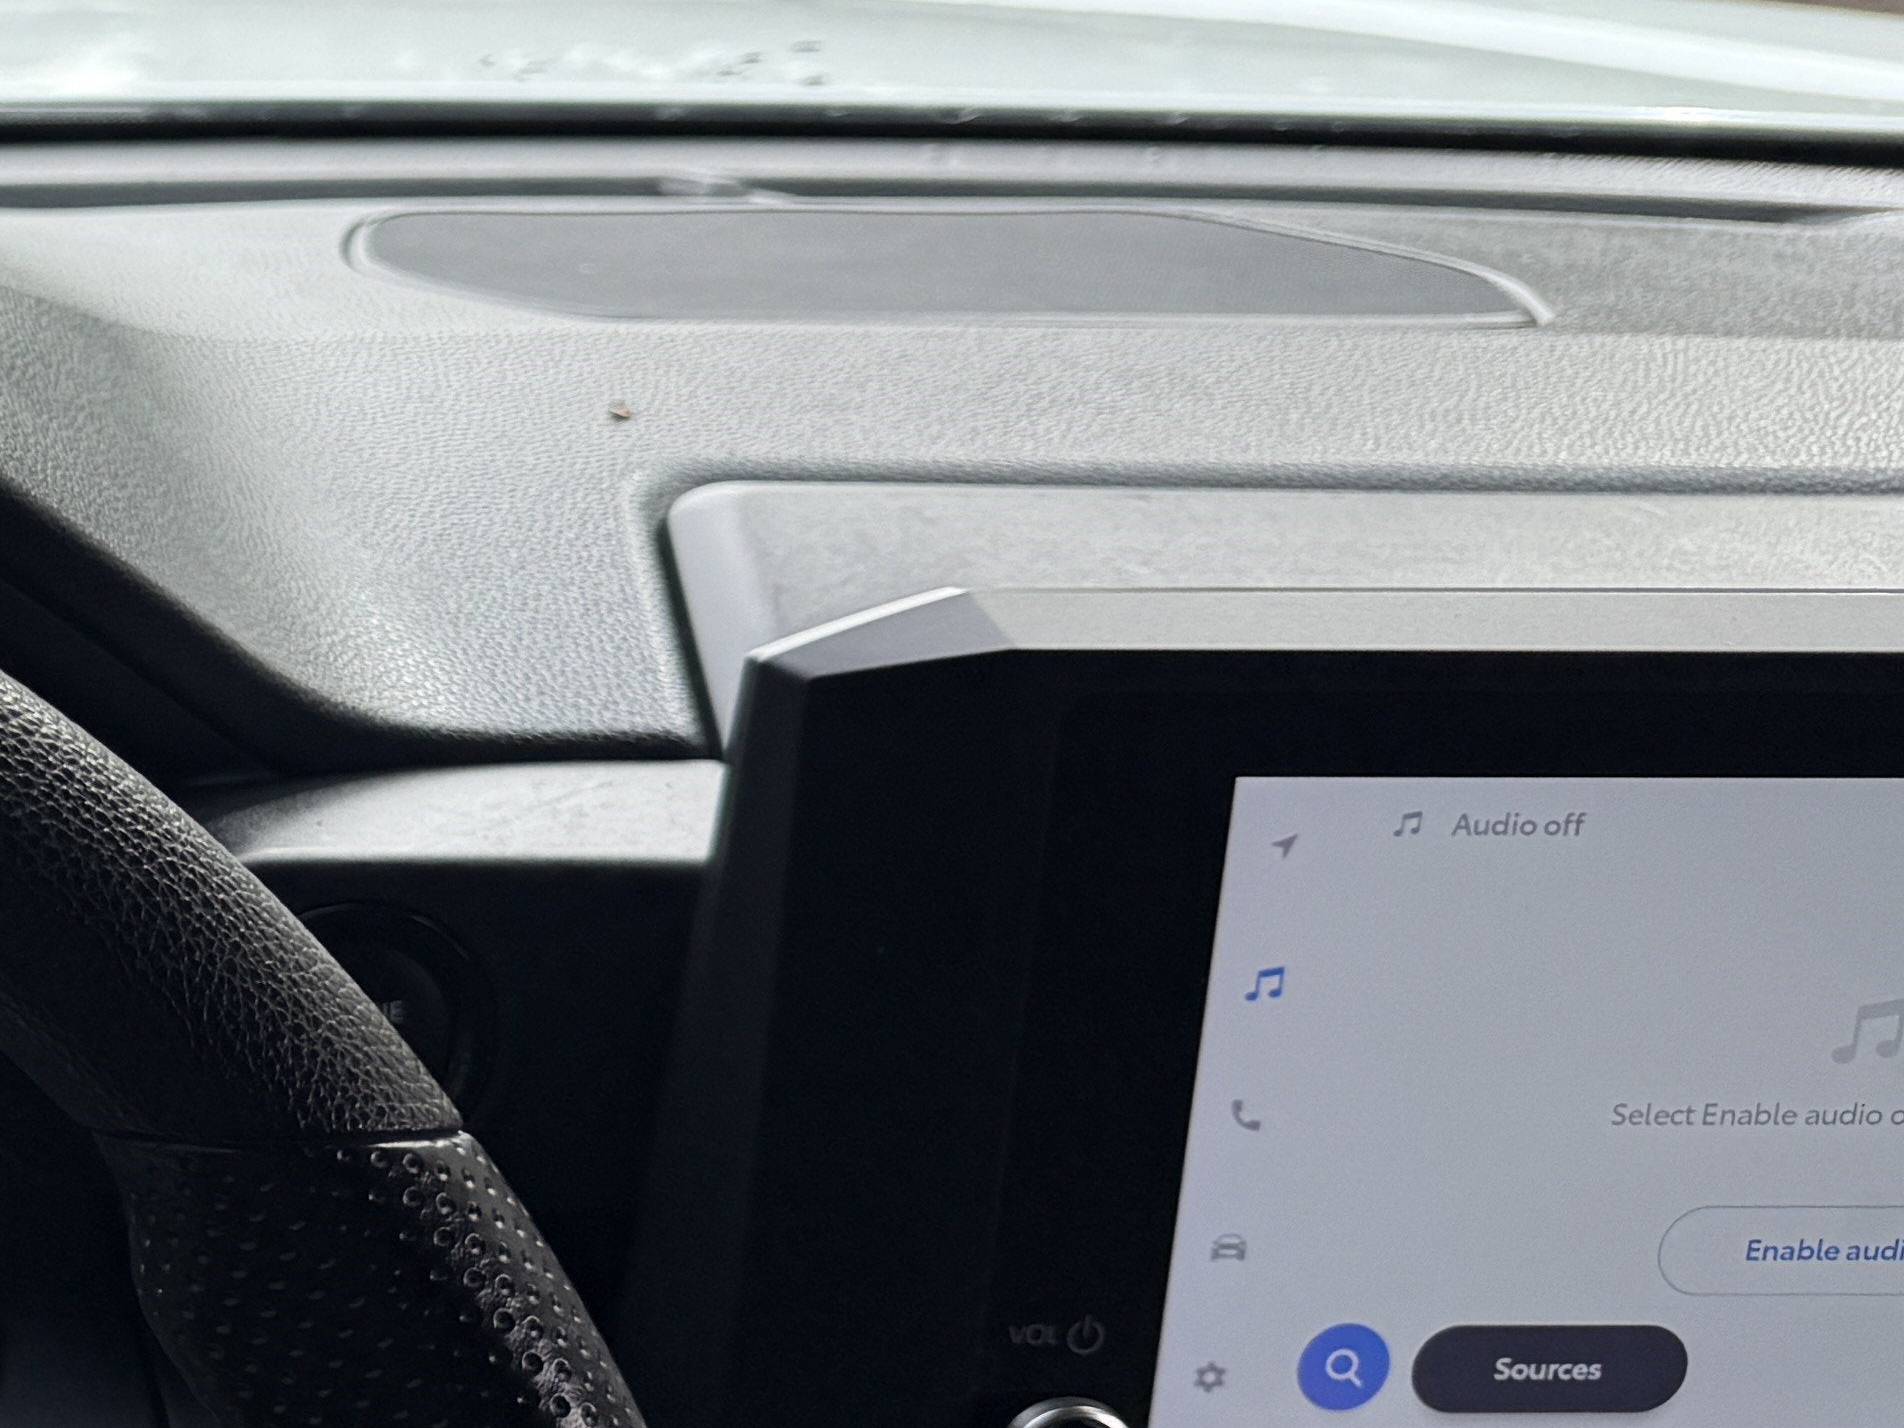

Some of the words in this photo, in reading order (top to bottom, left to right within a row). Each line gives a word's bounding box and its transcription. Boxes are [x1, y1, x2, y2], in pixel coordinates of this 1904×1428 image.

[1450, 811, 1538, 837] Audio
[1543, 811, 1588, 837] off
[1611, 1102, 1697, 1126] Select
[1702, 1101, 1799, 1126] Enable
[1804, 1101, 1883, 1126] audio
[1745, 1238, 1841, 1262] Enable
[1008, 1323, 1058, 1347] VOL
[1493, 1357, 1602, 1381] Sources
